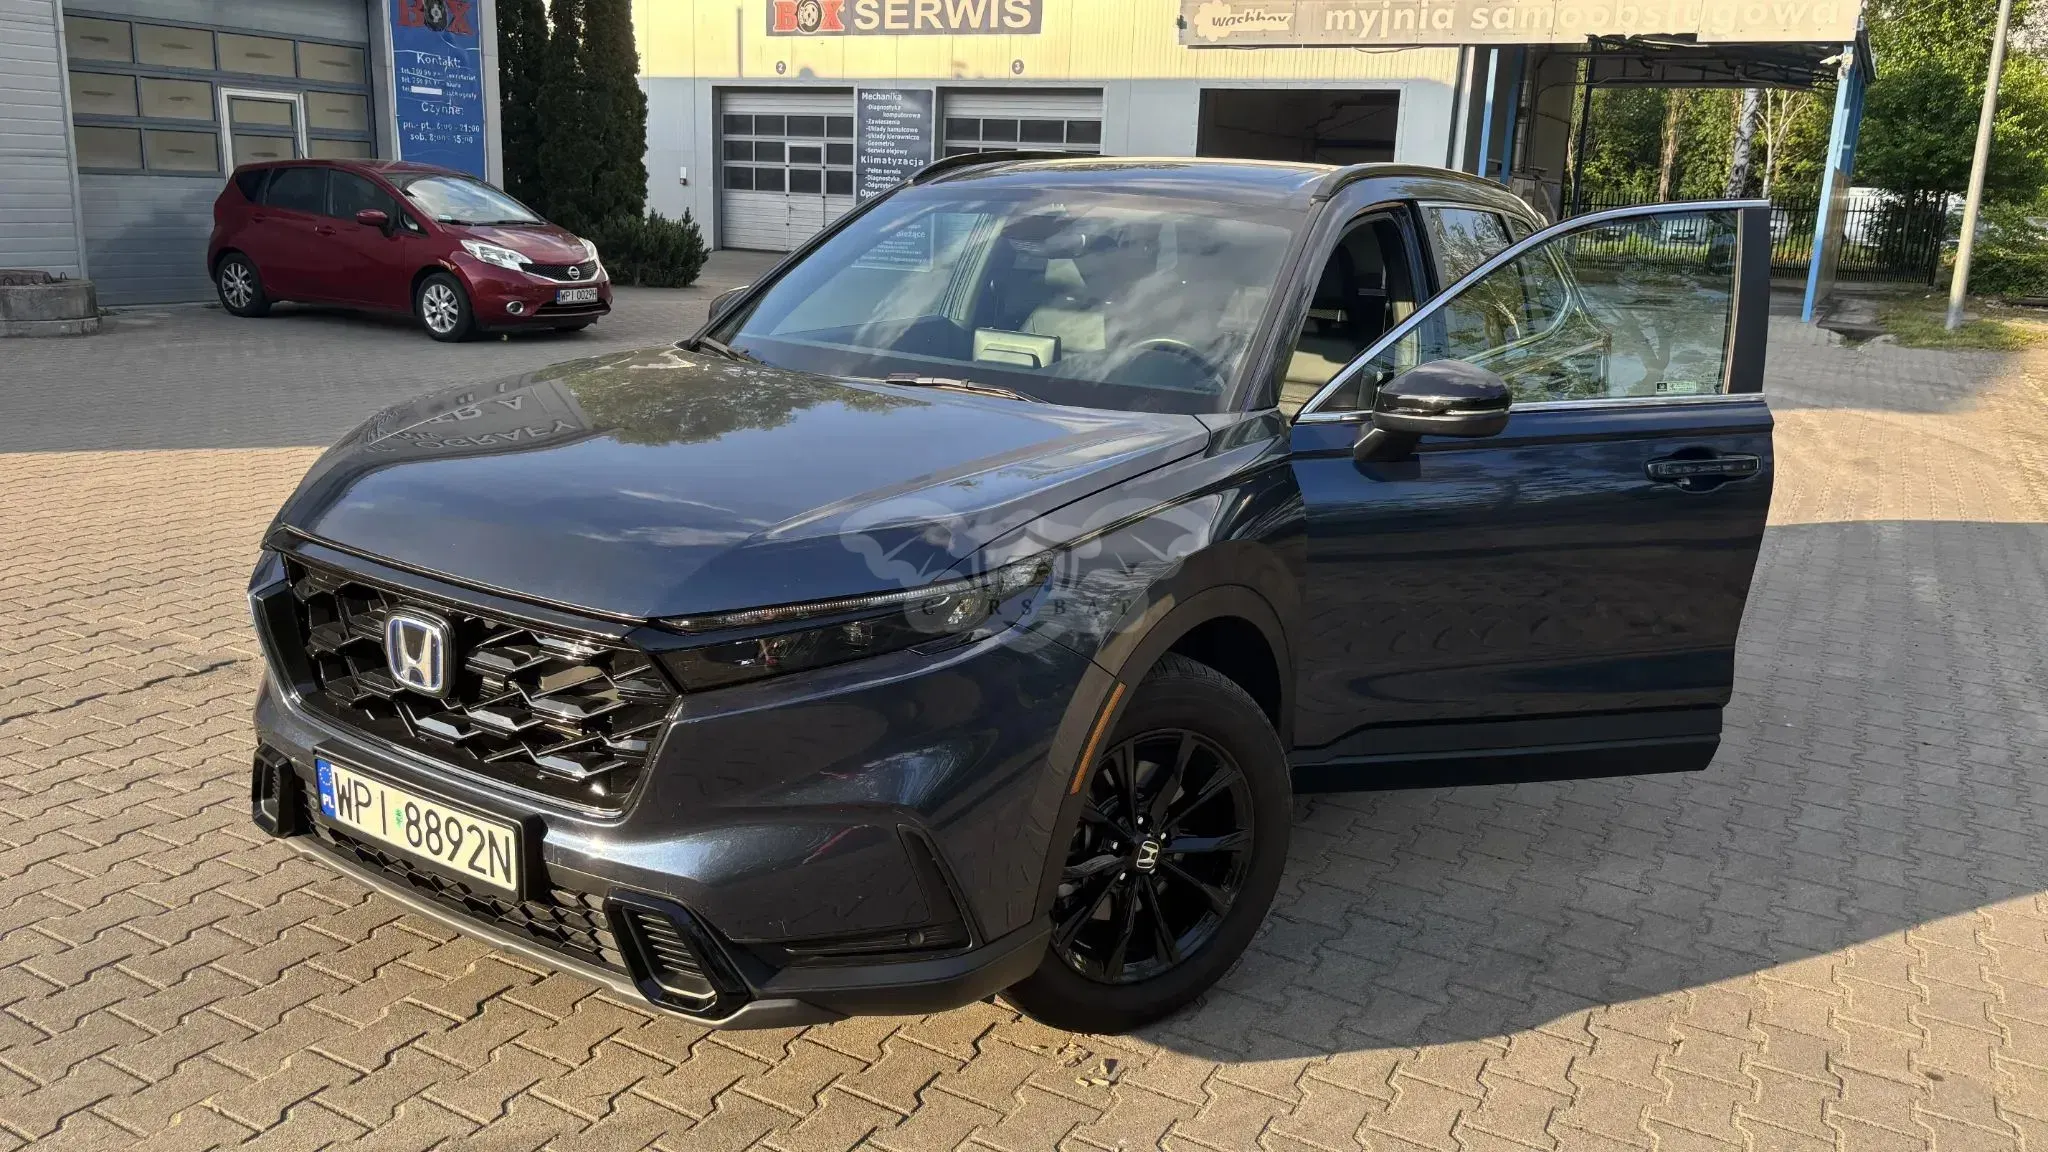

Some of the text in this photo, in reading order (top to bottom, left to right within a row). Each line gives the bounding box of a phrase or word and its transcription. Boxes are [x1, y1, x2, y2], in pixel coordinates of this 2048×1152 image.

[773, 0, 1033, 34] BOX SERWIS
[1325, 0, 1453, 38] myjnia
[861, 92, 902, 101] Mechanika
[860, 155, 924, 167] Klimatyzacja
[561, 291, 574, 301] WPI
[322, 793, 335, 809] PL
[333, 771, 512, 884] WPI 8892N
